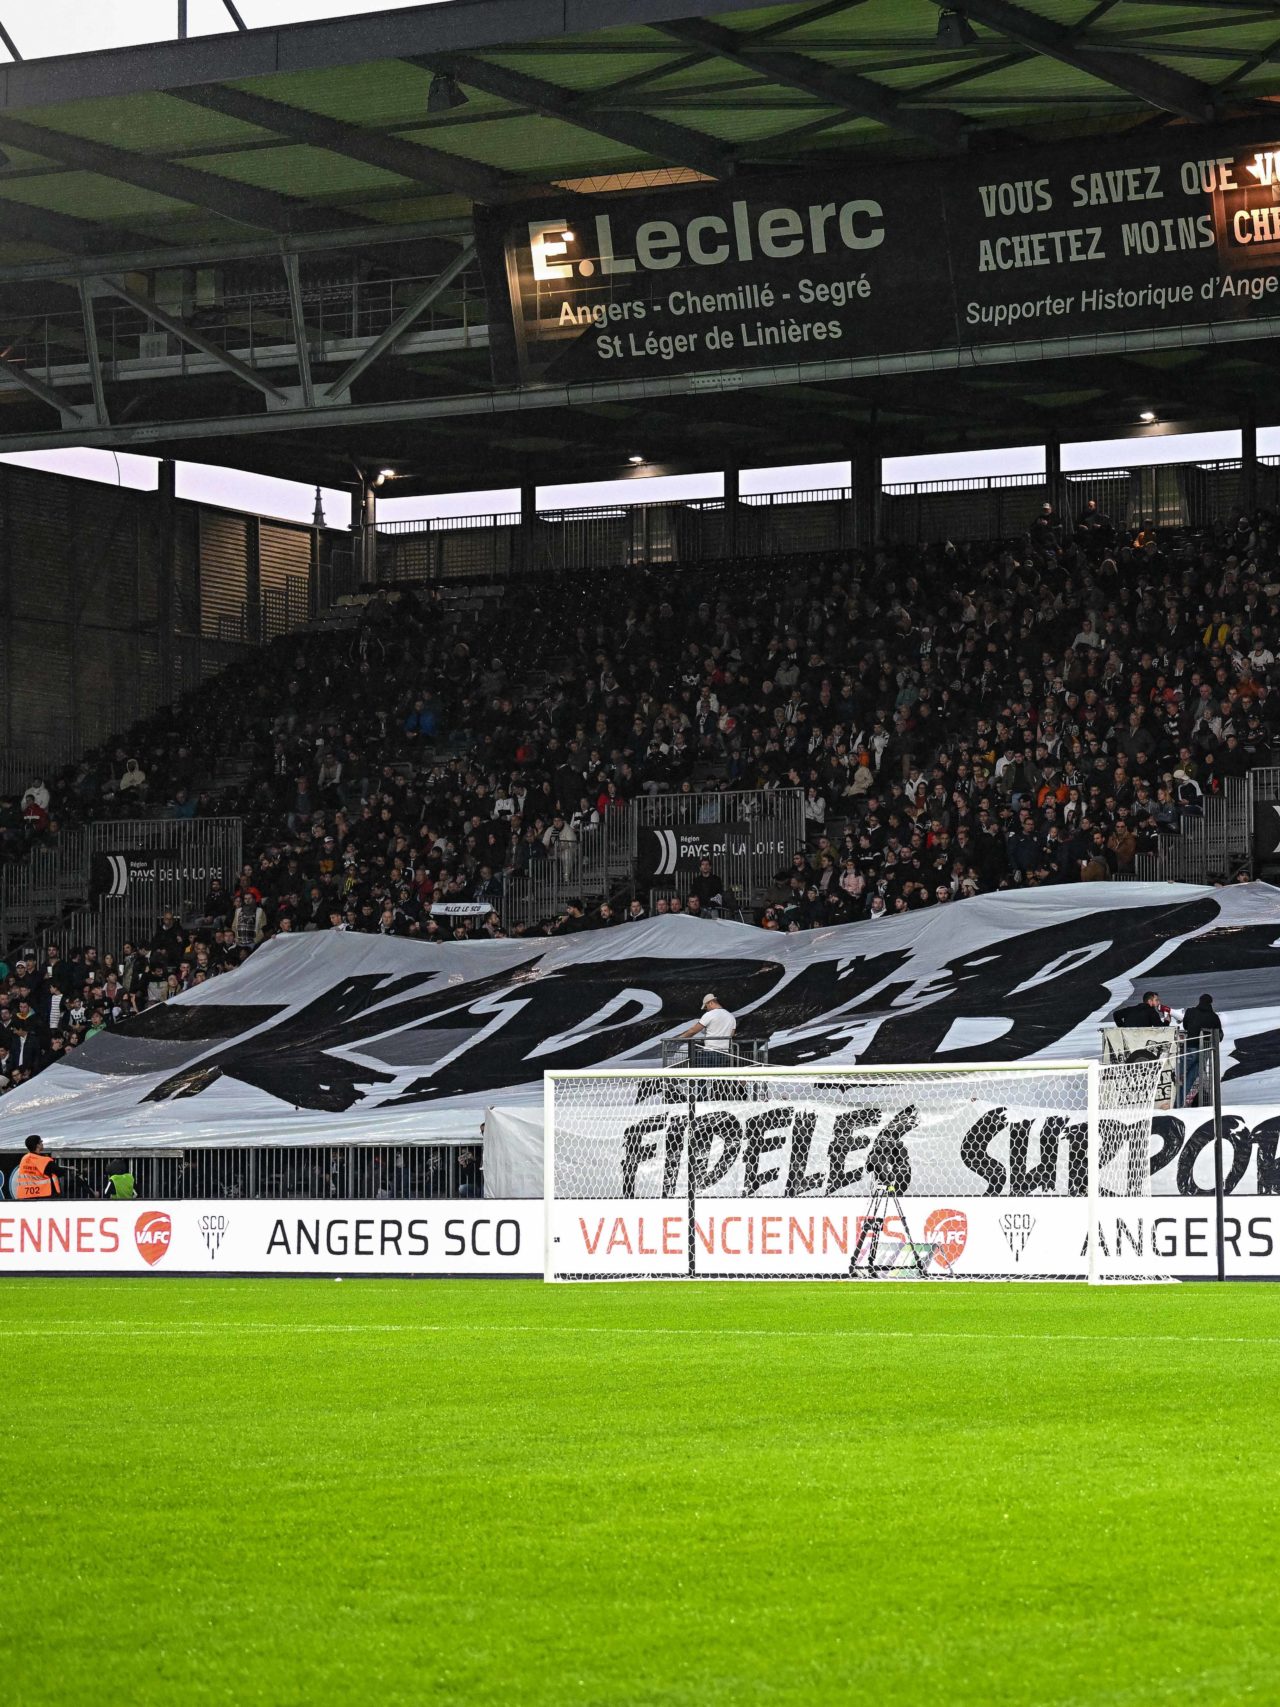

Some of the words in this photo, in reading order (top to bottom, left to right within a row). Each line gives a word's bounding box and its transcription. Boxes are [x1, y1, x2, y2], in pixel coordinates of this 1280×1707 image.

[979, 179, 1052, 217] VOUS
[1070, 165, 1163, 208] SAVEZ
[1181, 157, 1238, 195] QUE
[527, 199, 886, 281] E.Leclerc
[979, 227, 1105, 272] ACHETEZ
[1123, 215, 1216, 256] MOINS
[559, 295, 646, 329] Angers
[669, 281, 775, 316] Chemillé
[799, 273, 872, 308] Segré
[966, 292, 1074, 327] Supporter
[1081, 282, 1195, 316] Historique
[597, 335, 624, 359] St
[630, 324, 697, 360] Léger
[705, 323, 734, 350] de
[742, 317, 843, 347] Linières
[680, 844, 710, 857] PAYS
[160, 869, 173, 881] DE
[192, 867, 222, 880] LORE
[25, 1186, 40, 1195] 702
[135, 1230, 170, 1245] VAFC
[201, 1215, 226, 1231] SCO
[266, 1218, 430, 1255] ANGERS
[444, 1218, 521, 1256] SCO
[1004, 1213, 1031, 1230] SCO
[1080, 1217, 1273, 1257] ANGERS
